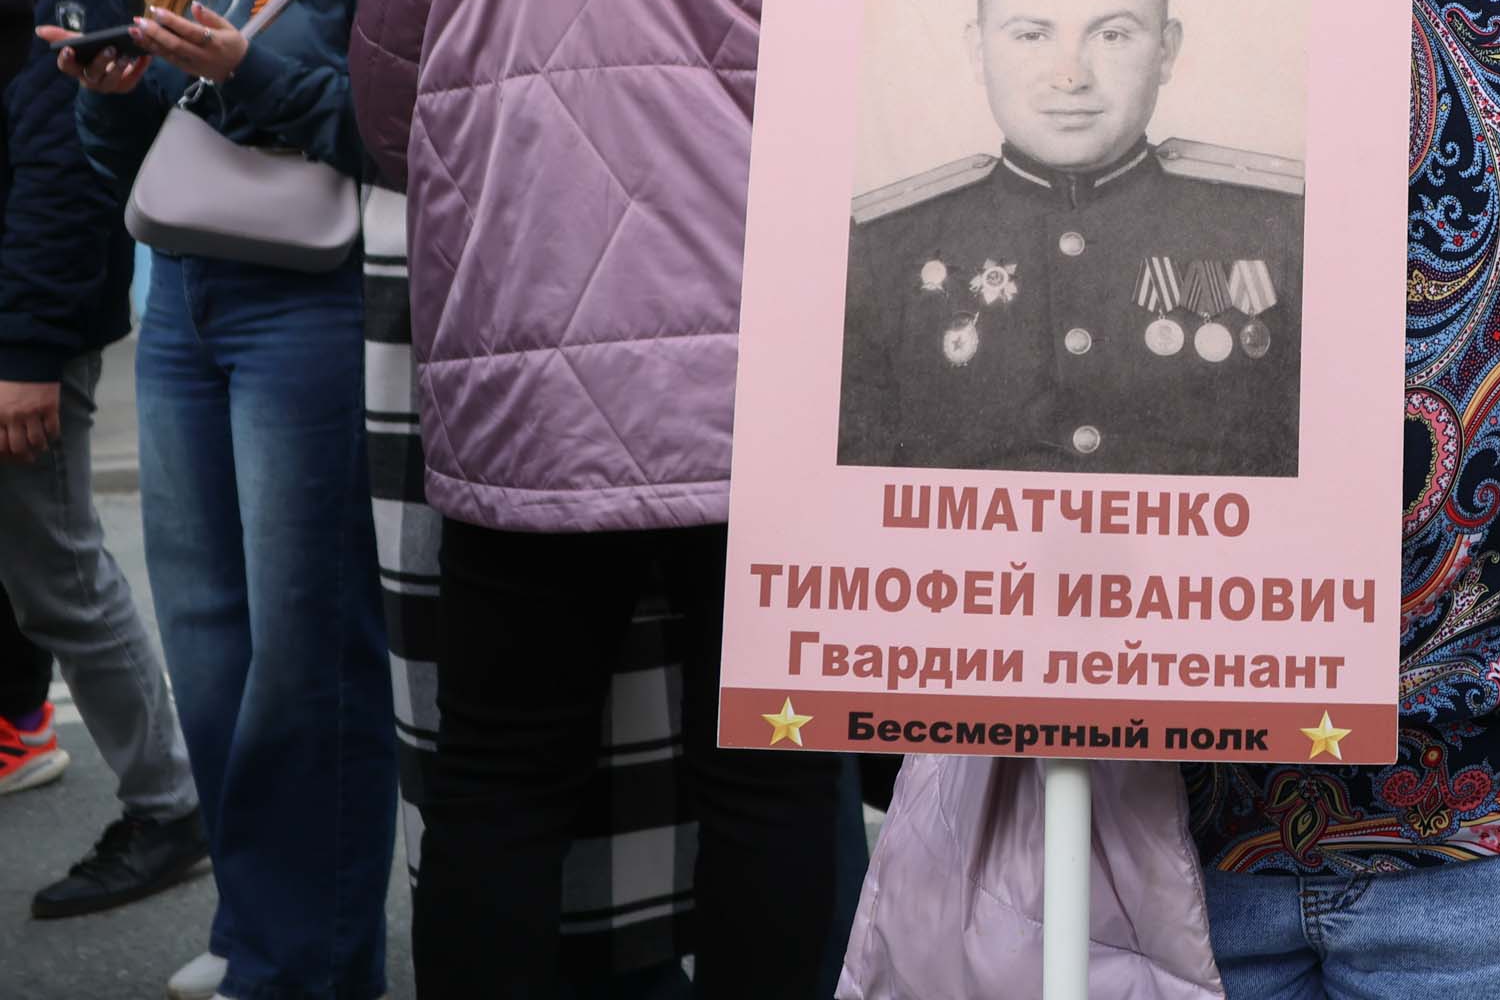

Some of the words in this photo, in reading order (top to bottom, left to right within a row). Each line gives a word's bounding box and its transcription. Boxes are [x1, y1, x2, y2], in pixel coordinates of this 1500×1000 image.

[882, 484, 1250, 538] ШМАТЧЕНКО
[750, 561, 1035, 617] ТИМОФЕЙ
[1057, 573, 1376, 624] ИВАНОВИЧ
[788, 630, 1024, 691] Гвардии
[1042, 639, 1345, 689] лейтенант
[847, 711, 1149, 753] Бессмертный
[1165, 727, 1268, 751] полк
